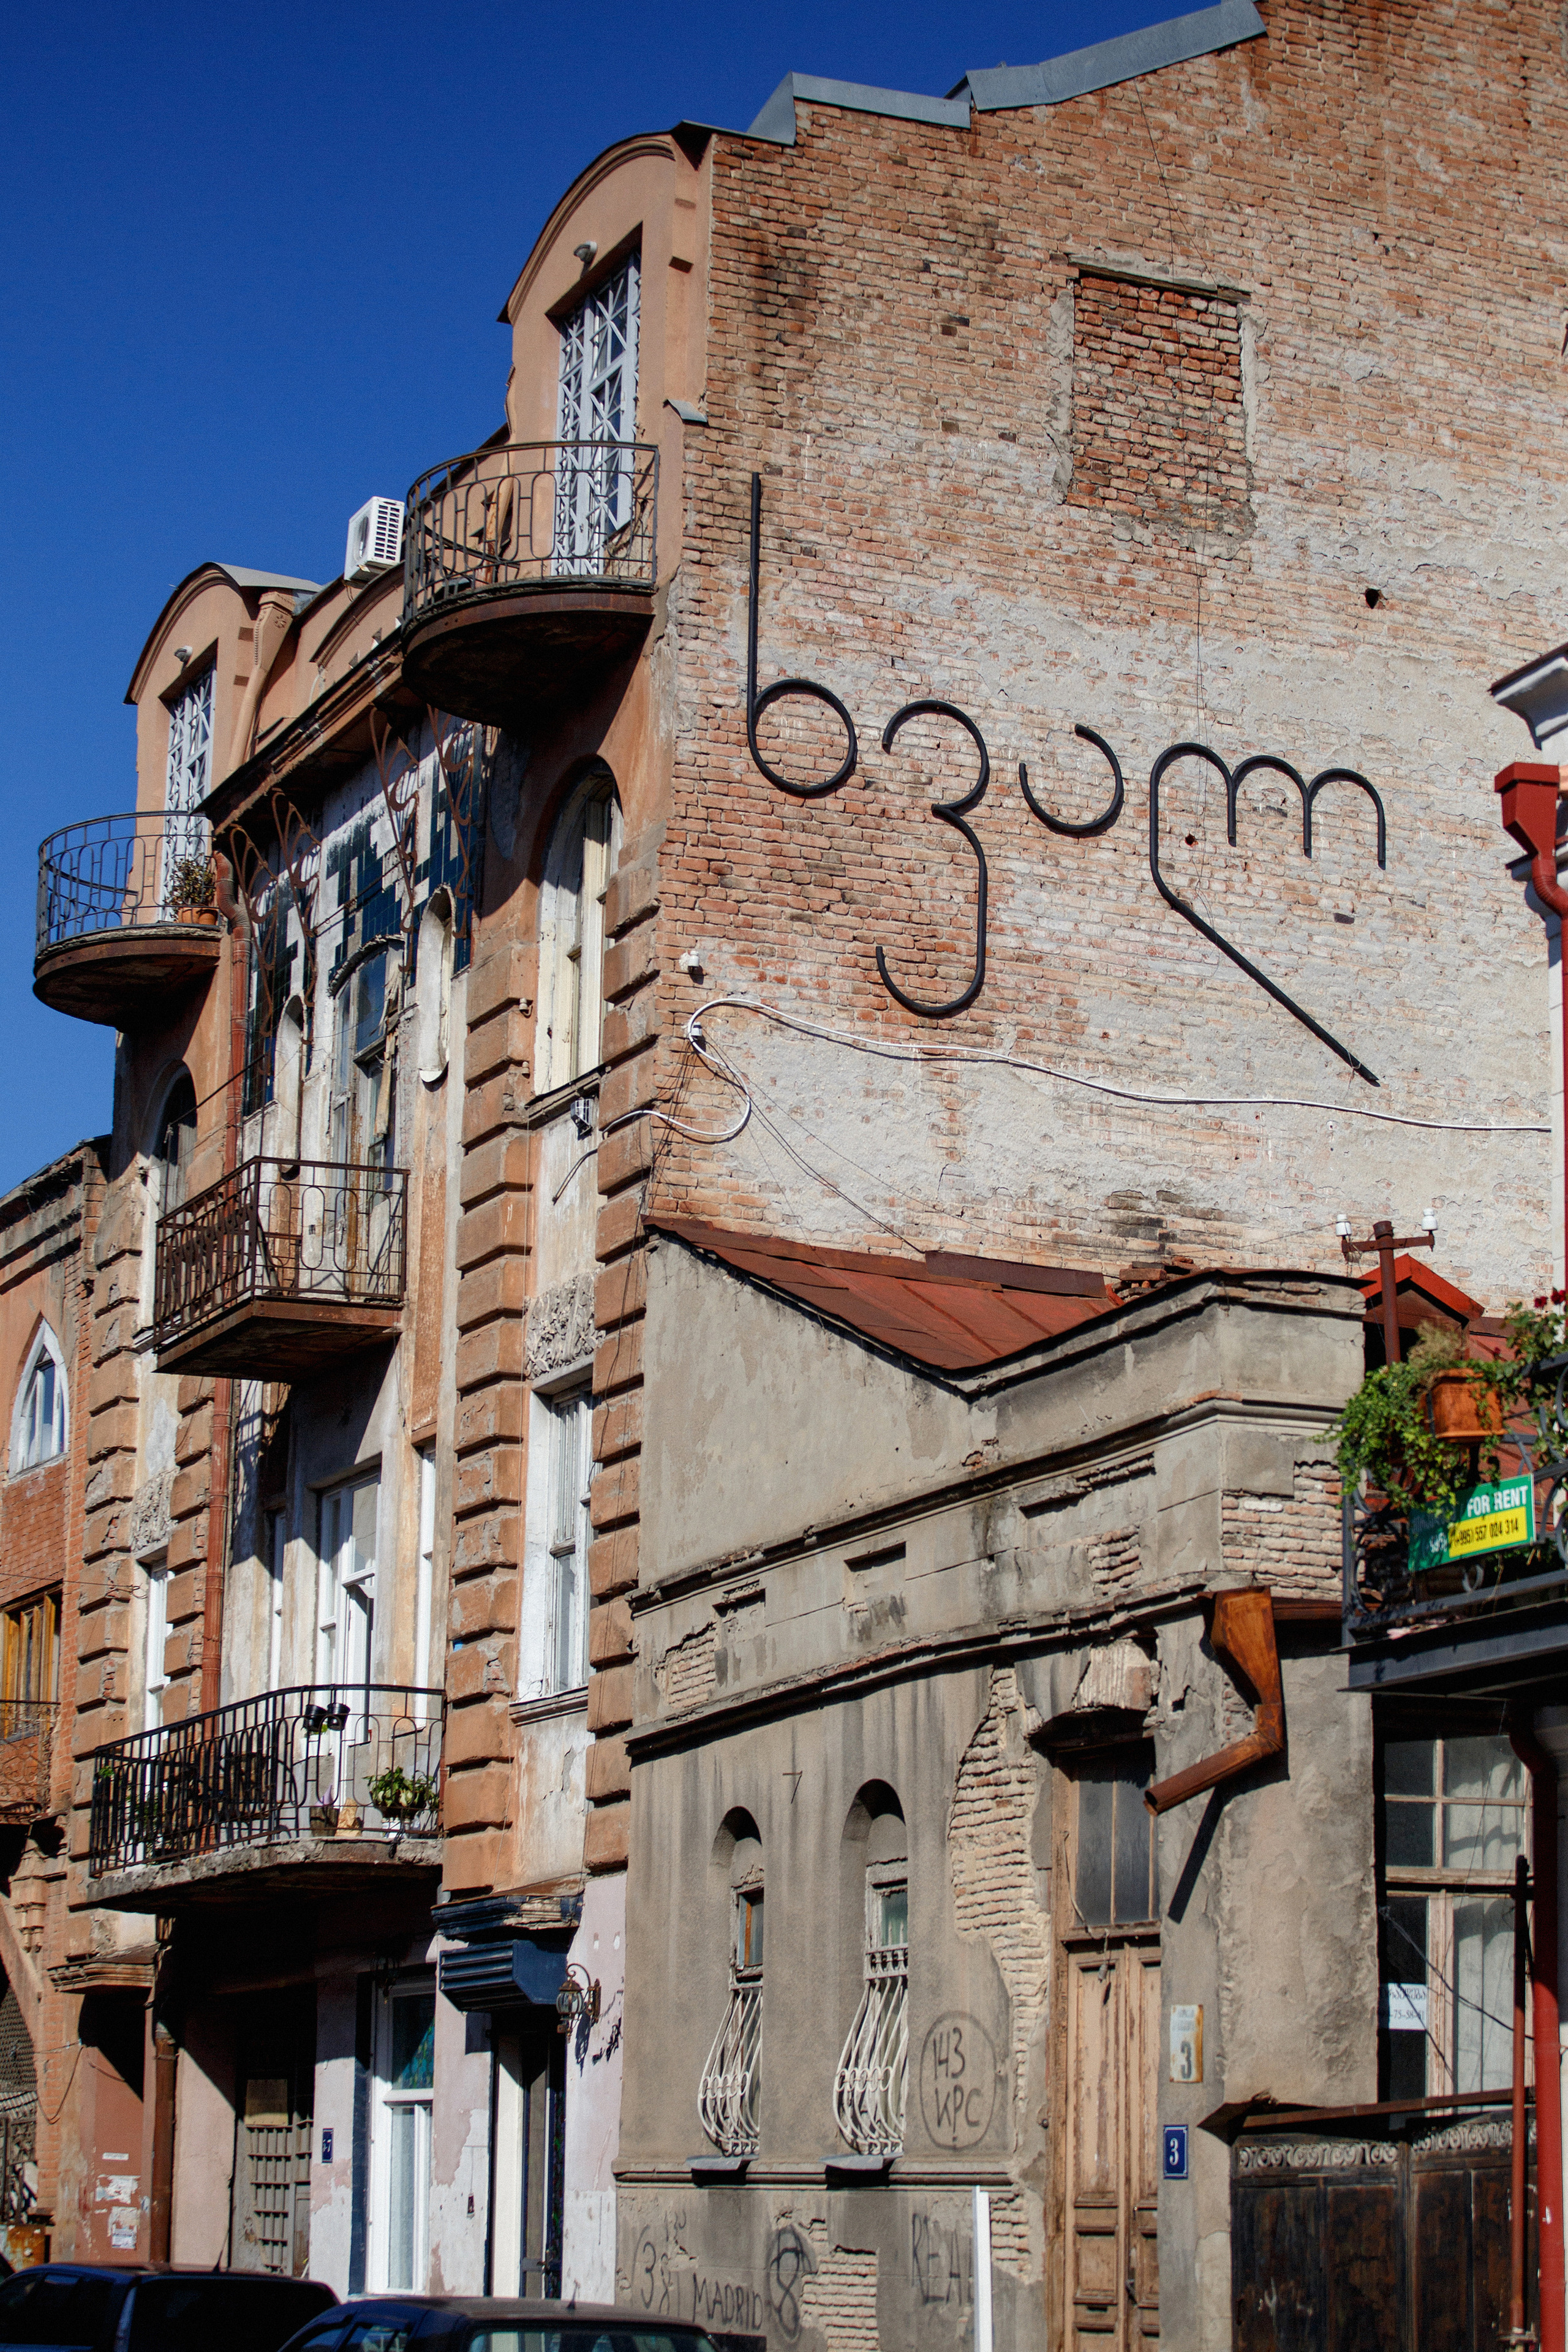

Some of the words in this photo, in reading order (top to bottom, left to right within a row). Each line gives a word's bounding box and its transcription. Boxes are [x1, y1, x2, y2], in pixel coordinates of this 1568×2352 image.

[1467, 1494, 1491, 1518] FOR
[1493, 1485, 1529, 1511] RENT
[1474, 1525, 1487, 1542] 557
[1504, 1517, 1518, 1535] 314
[933, 2027, 965, 2080] 143
[1180, 2040, 1192, 2079] 3
[1169, 2138, 1179, 2166] 3
[693, 2273, 763, 2331] MADRID
